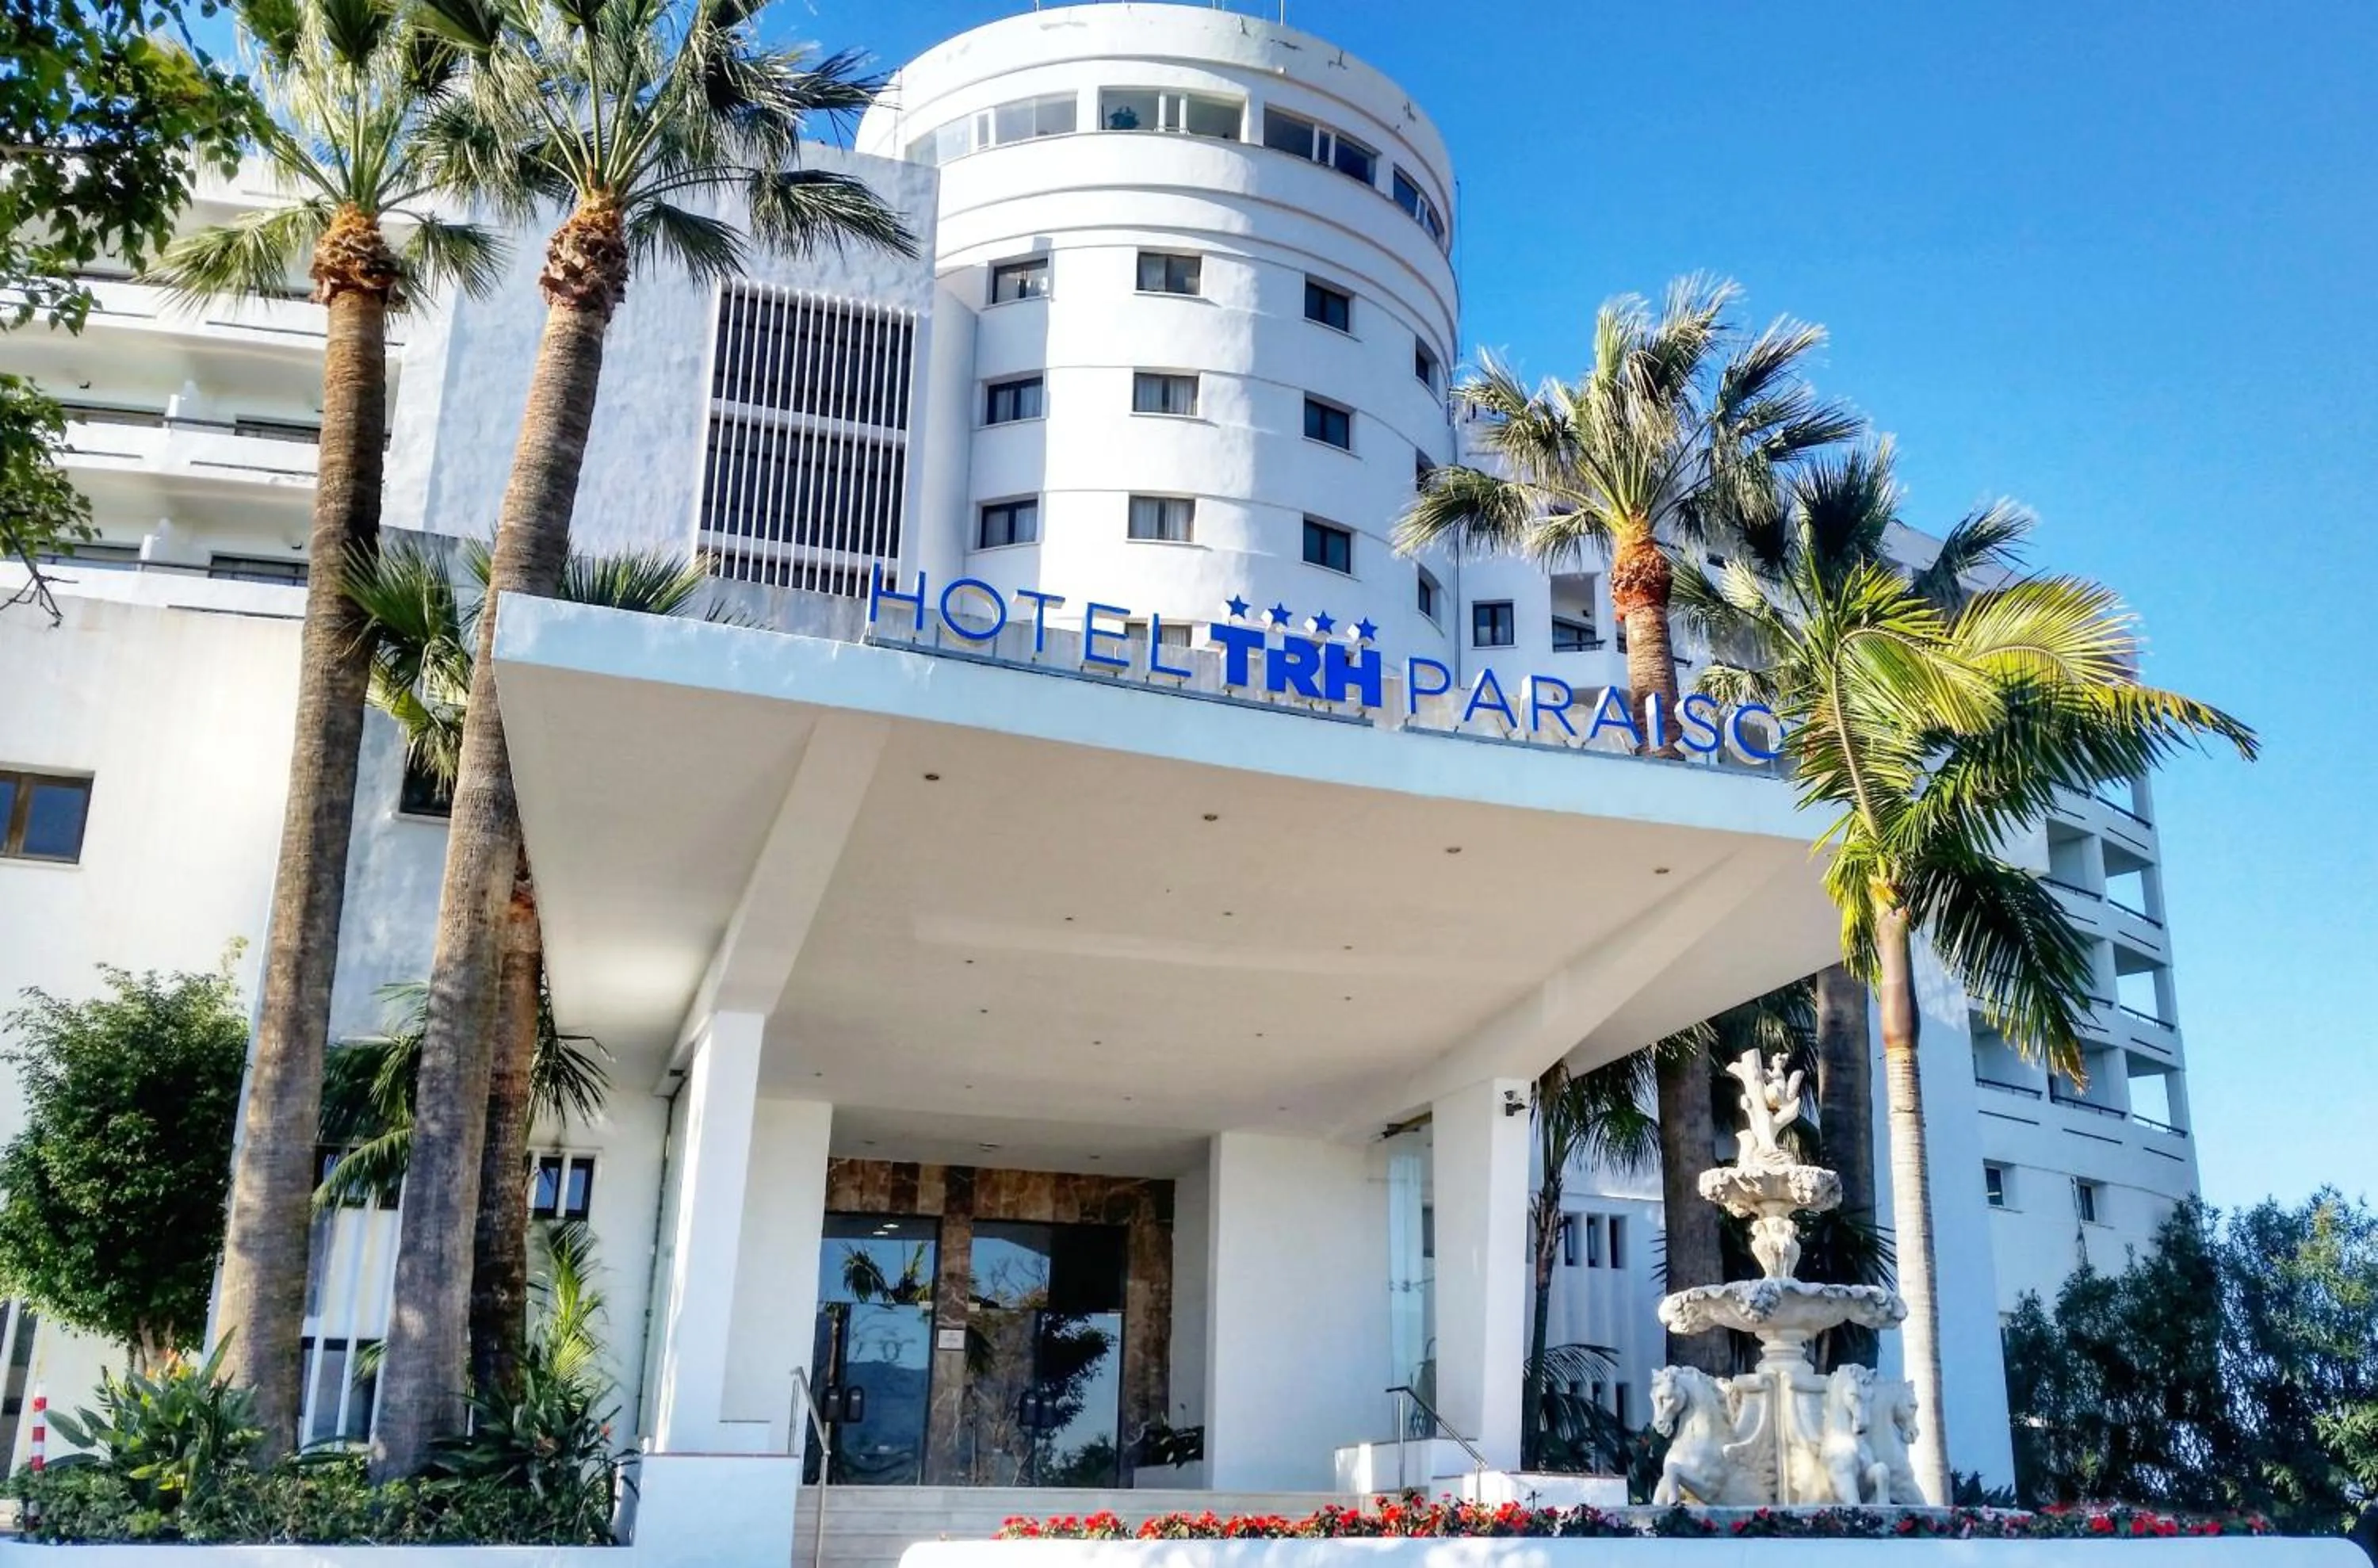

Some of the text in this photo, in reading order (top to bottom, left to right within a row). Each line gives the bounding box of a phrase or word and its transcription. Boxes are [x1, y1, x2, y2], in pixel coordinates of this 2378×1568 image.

[867, 562, 1788, 762] HOTEL TRH PARAISO
